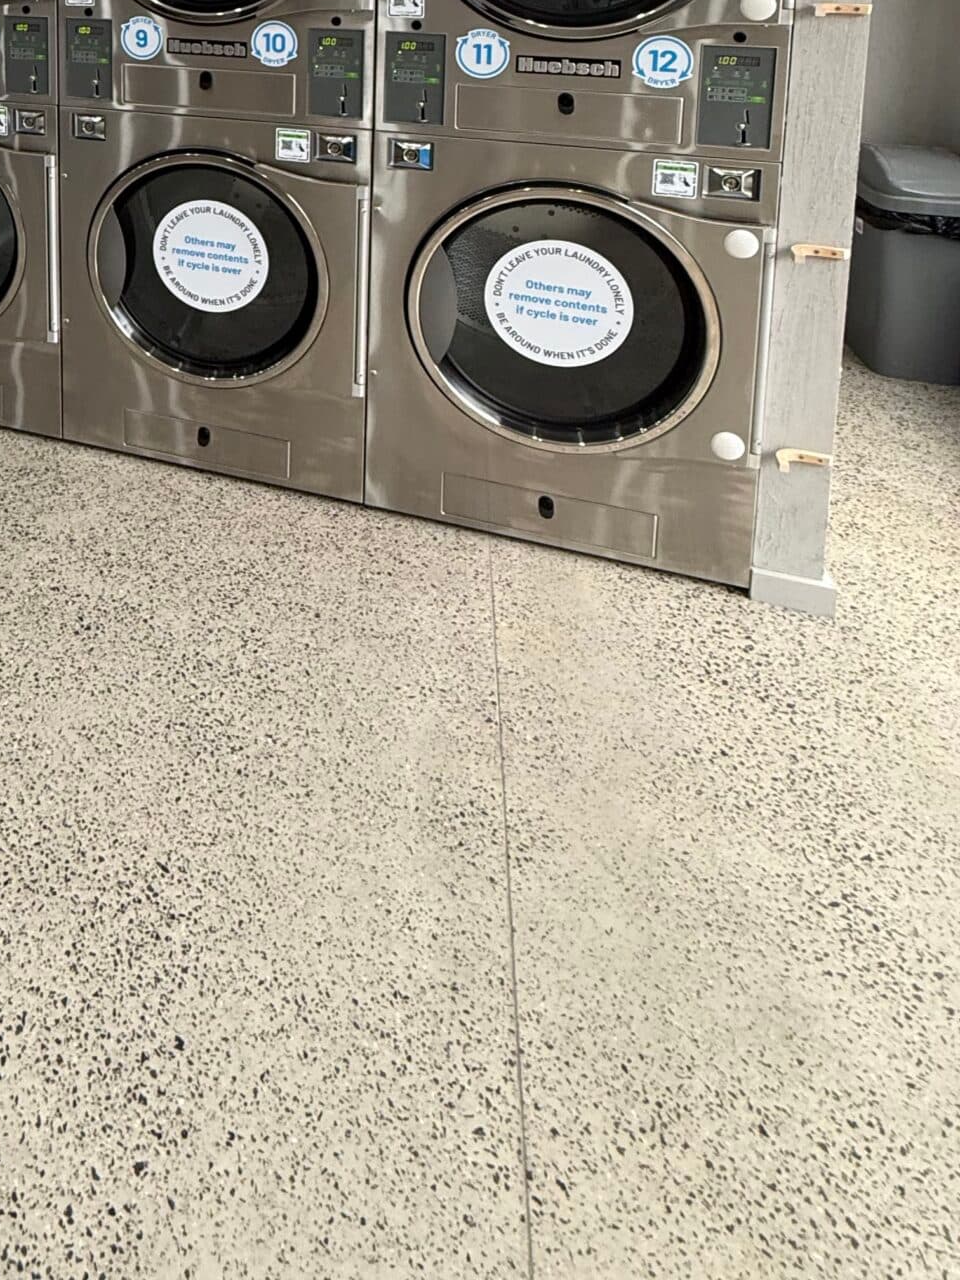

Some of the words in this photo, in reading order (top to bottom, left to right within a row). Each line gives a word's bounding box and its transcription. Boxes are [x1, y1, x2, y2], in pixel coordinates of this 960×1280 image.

[135, 29, 148, 48] 9
[262, 33, 286, 53] 10
[470, 31, 496, 39] DRYER
[168, 39, 246, 57] Huebsch
[473, 44, 492, 64] 11
[518, 56, 619, 77] Huebsch
[649, 50, 677, 72] 12
[648, 77, 677, 85] DRYER
[160, 228, 171, 251] DON'T
[167, 210, 189, 230] LEAVE
[189, 207, 211, 215] YOUR
[213, 207, 249, 232] LAUNDRY
[247, 232, 262, 265] LONELY
[184, 235, 214, 247] Others
[217, 241, 236, 252] may
[172, 248, 205, 258] remove
[208, 253, 249, 264] contents
[186, 261, 209, 271] cycle
[212, 263, 220, 272] is
[222, 265, 241, 274] over
[163, 265, 173, 277] BE
[170, 277, 199, 302] AROUND
[201, 297, 225, 306] WHEN
[227, 293, 241, 305] IT'S
[240, 278, 257, 297] DONE
[493, 271, 508, 296] DON'T
[504, 251, 533, 272] LEAVE
[534, 248, 562, 257] YOUR
[565, 249, 611, 278] LAUNDRY
[607, 278, 624, 315] LONELY
[526, 280, 564, 293] Others
[567, 288, 592, 300] may
[509, 293, 551, 305] remove
[554, 299, 608, 314] contents
[516, 305, 524, 315] if
[527, 308, 556, 320] cycle
[560, 312, 569, 321] is
[572, 315, 598, 326] over
[496, 312, 508, 326] BE
[504, 326, 541, 354] AROUND
[543, 349, 574, 359] WHEN
[576, 347, 595, 359] IT'S
[594, 329, 618, 351] DONE
